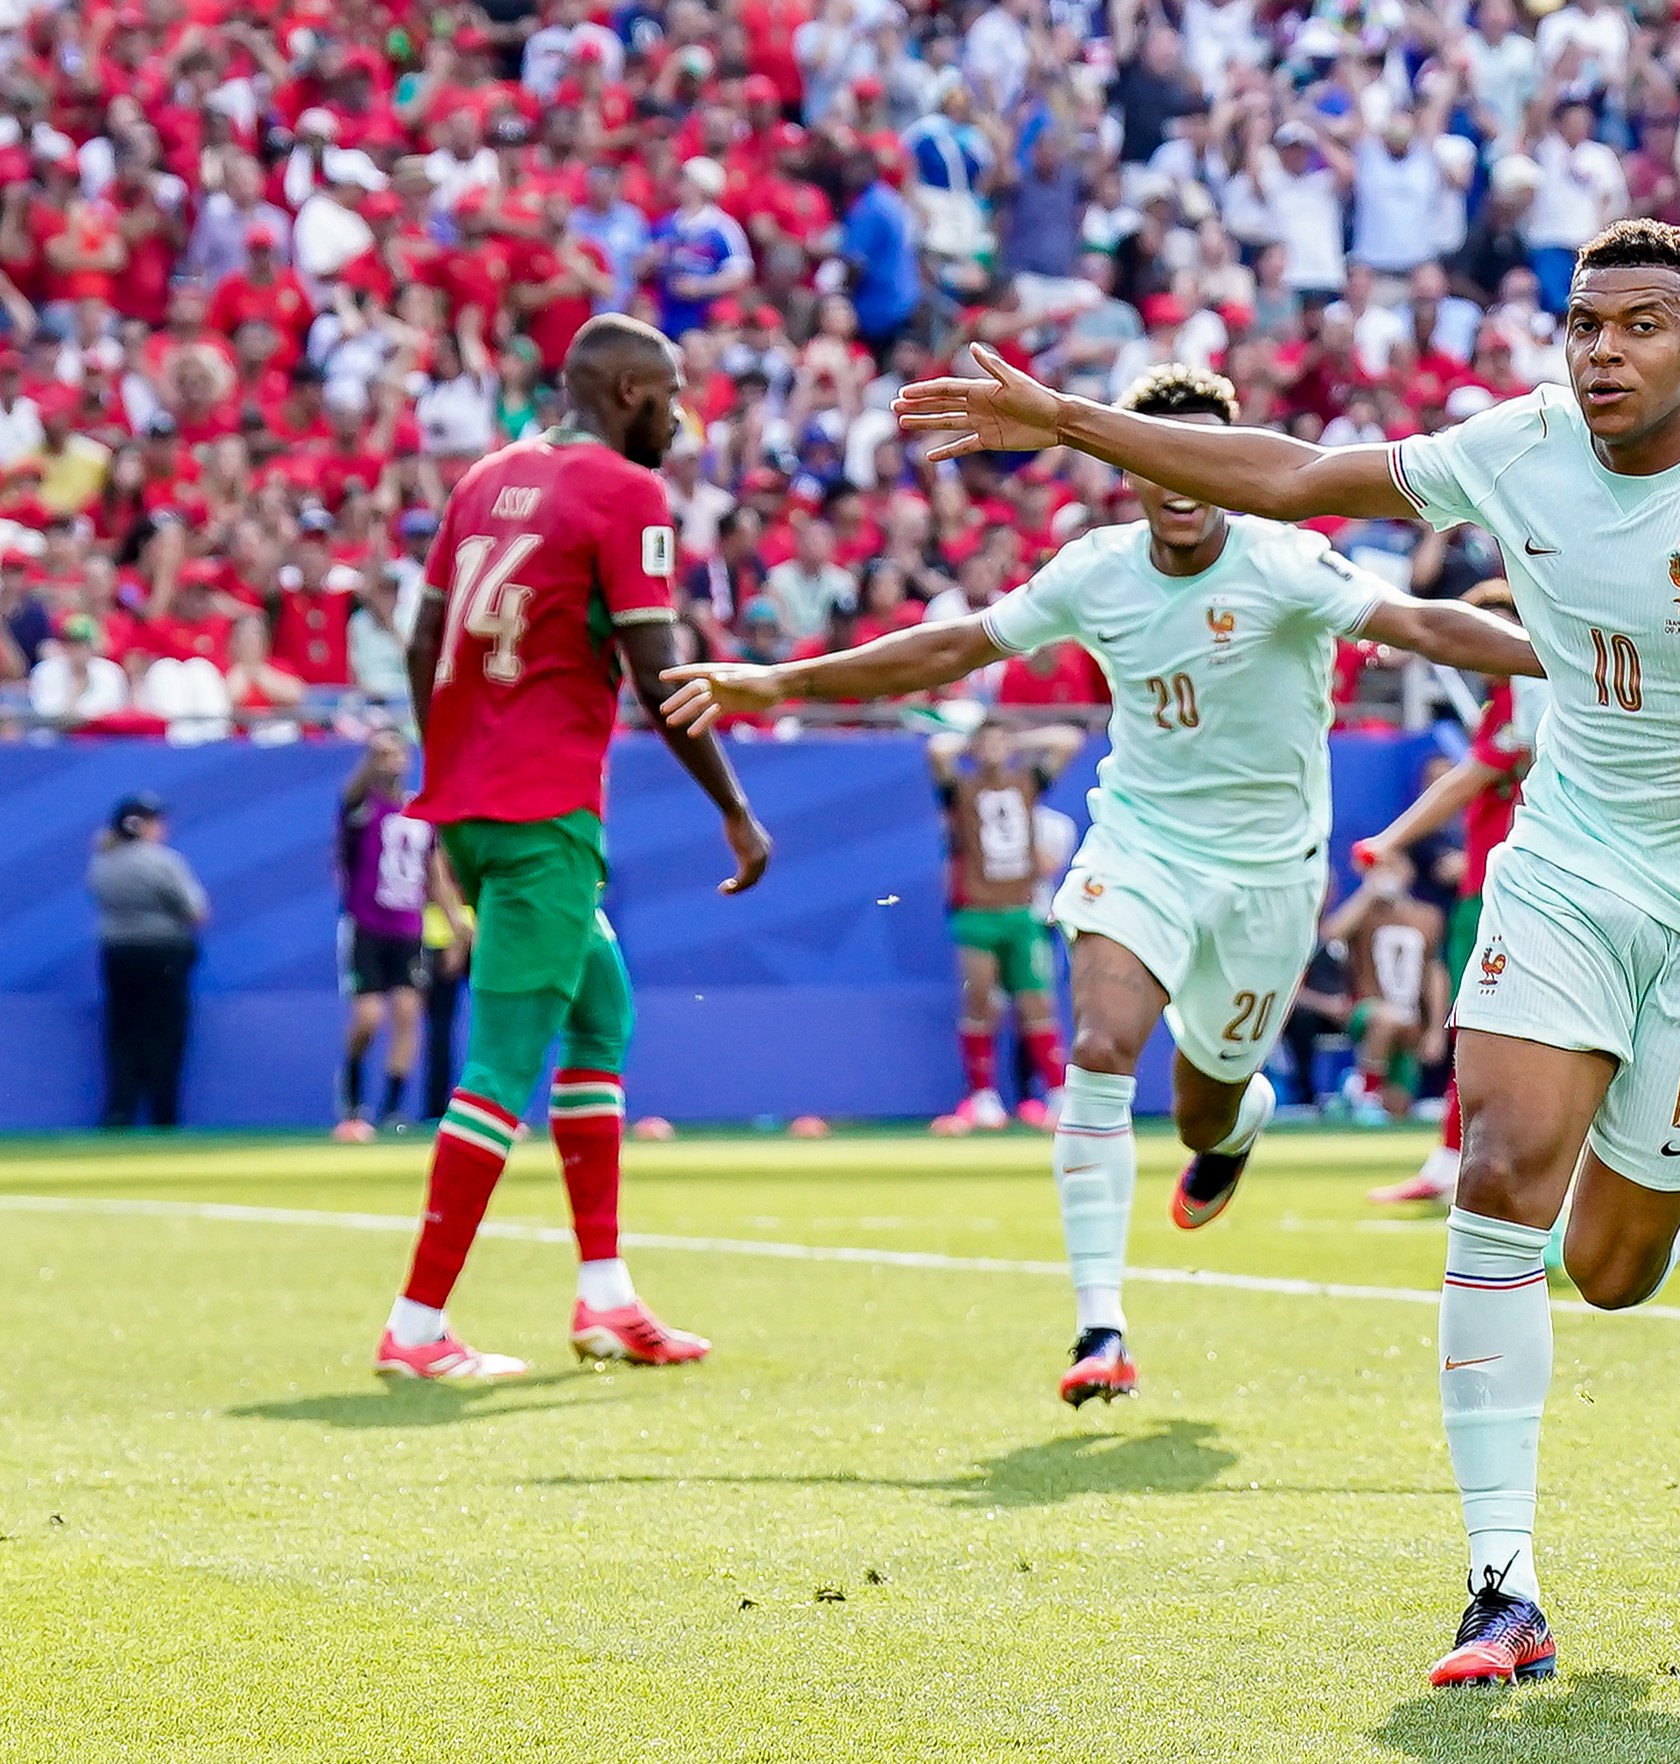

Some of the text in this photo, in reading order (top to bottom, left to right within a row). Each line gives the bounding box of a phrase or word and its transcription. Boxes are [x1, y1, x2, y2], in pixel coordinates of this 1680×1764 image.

[434, 533, 544, 684] 14
[1147, 672, 1200, 731] 20
[1589, 627, 1643, 713] 10
